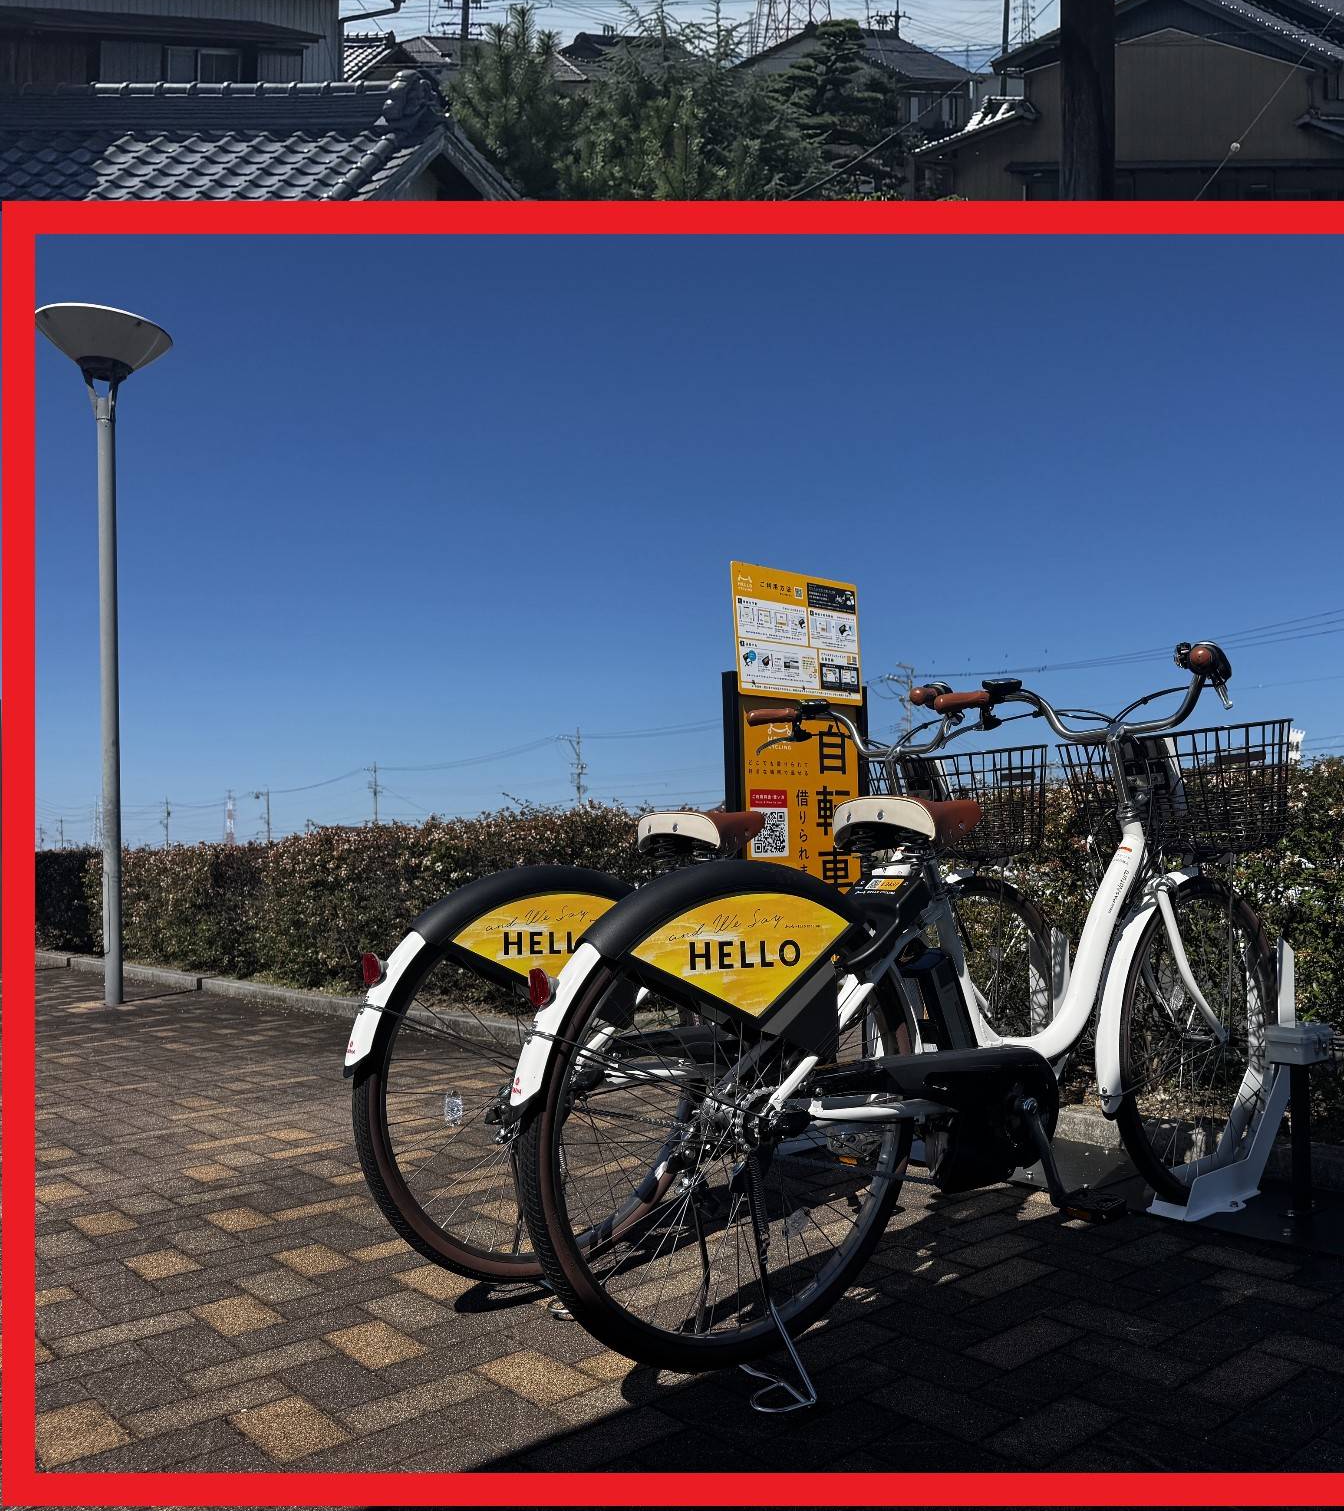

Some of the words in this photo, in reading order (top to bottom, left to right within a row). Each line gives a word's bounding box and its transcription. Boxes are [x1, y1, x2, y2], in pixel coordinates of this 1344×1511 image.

[525, 909, 551, 925] We
[668, 923, 705, 941] and
[713, 913, 742, 933] We
[747, 908, 783, 928] Say
[503, 931, 577, 955] HELL
[689, 939, 801, 971] HELLO
